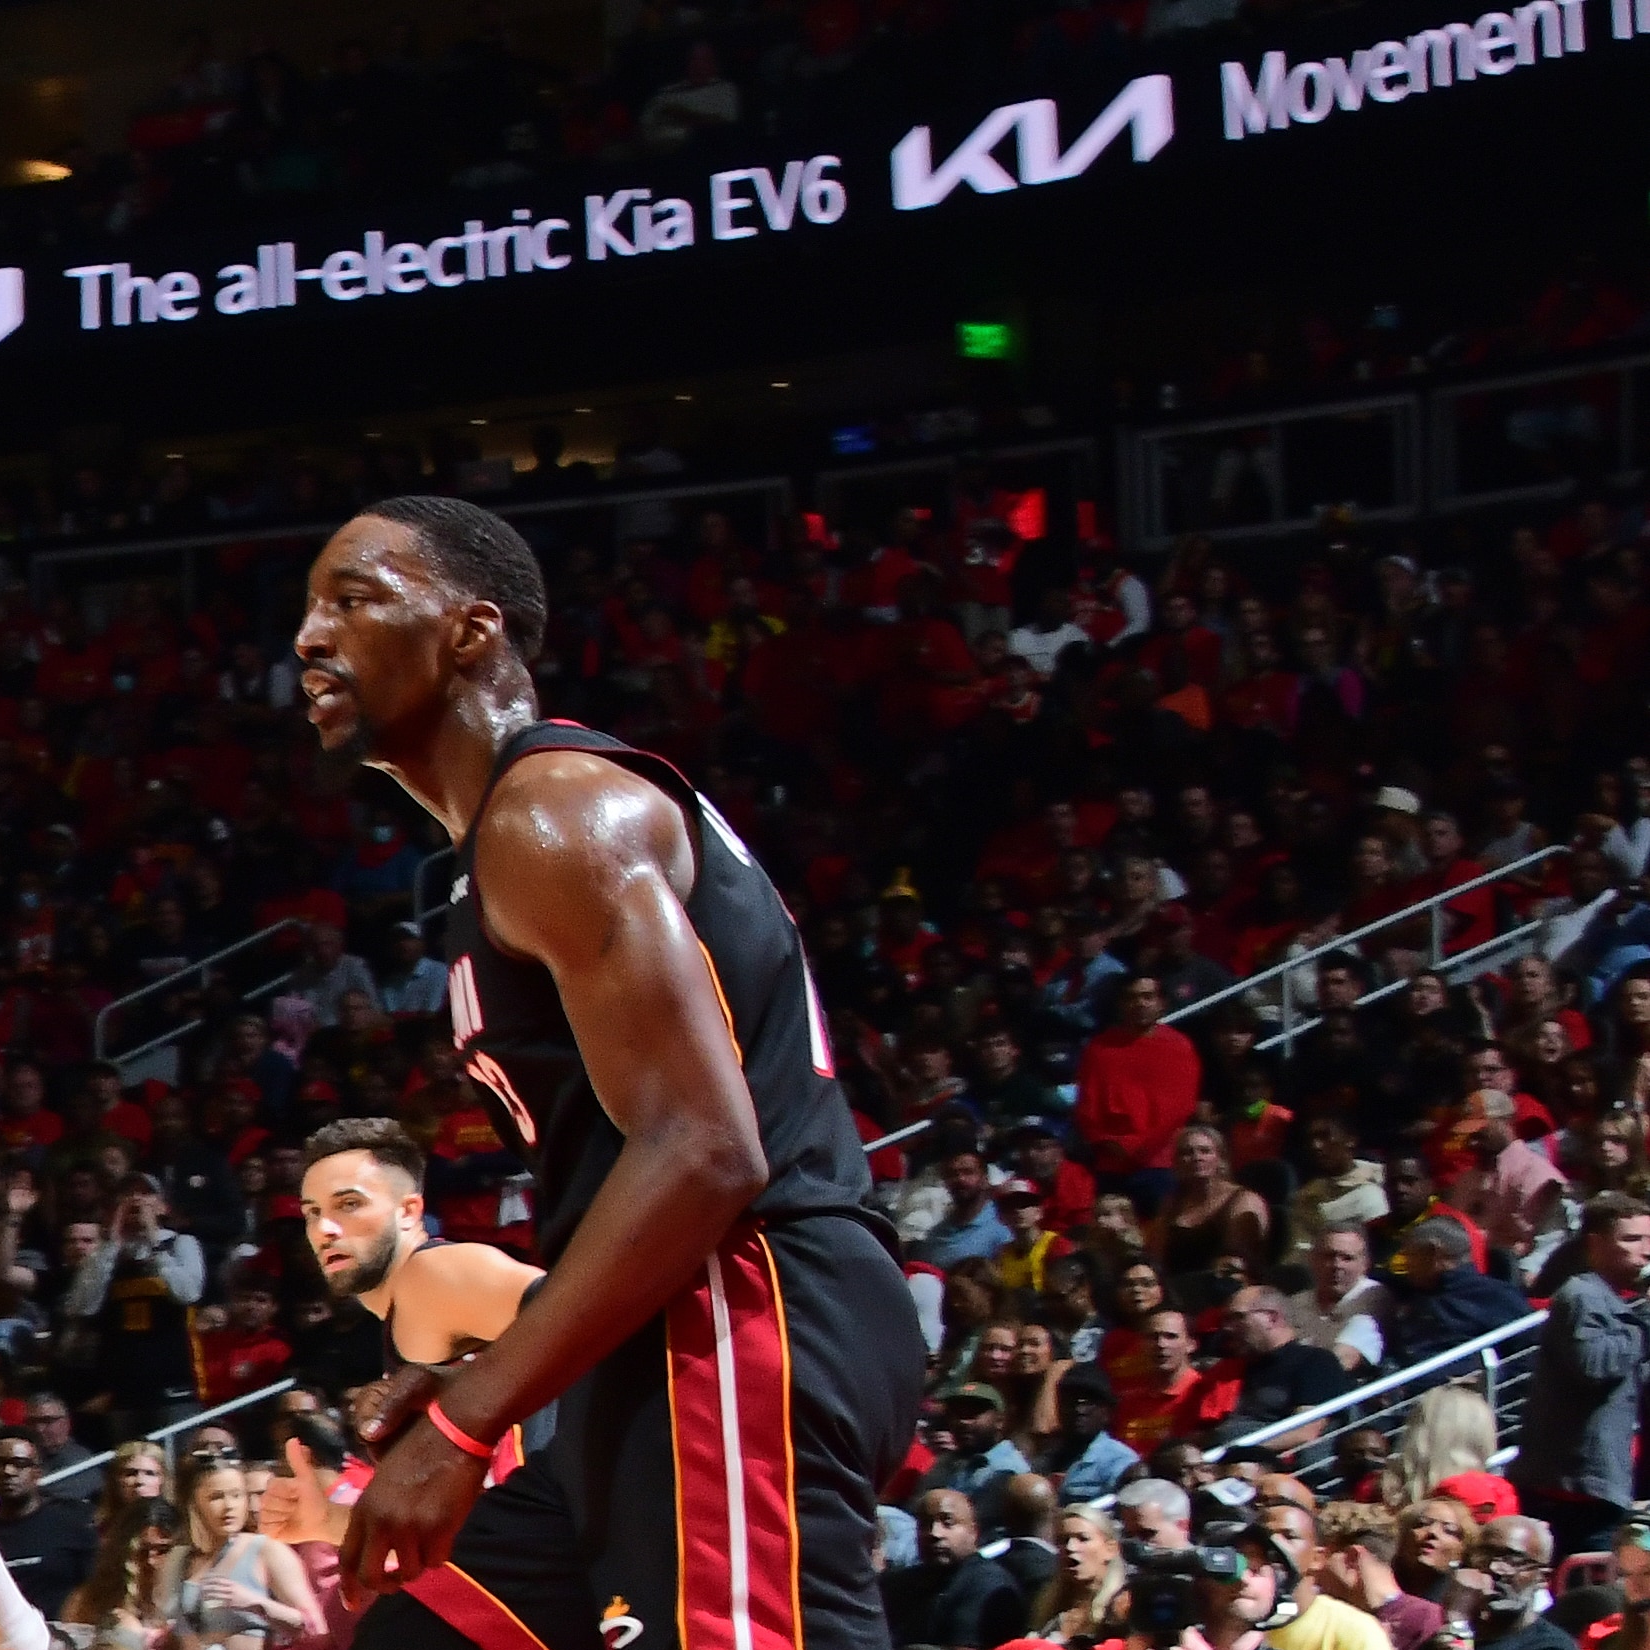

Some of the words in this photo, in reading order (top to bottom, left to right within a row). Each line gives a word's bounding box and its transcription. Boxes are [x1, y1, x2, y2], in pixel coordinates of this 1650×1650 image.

[1221, 0, 1587, 140] Movement
[63, 262, 201, 330] The
[215, 208, 572, 315] all-electric
[584, 188, 695, 261] Kia
[709, 154, 847, 240] EV6
